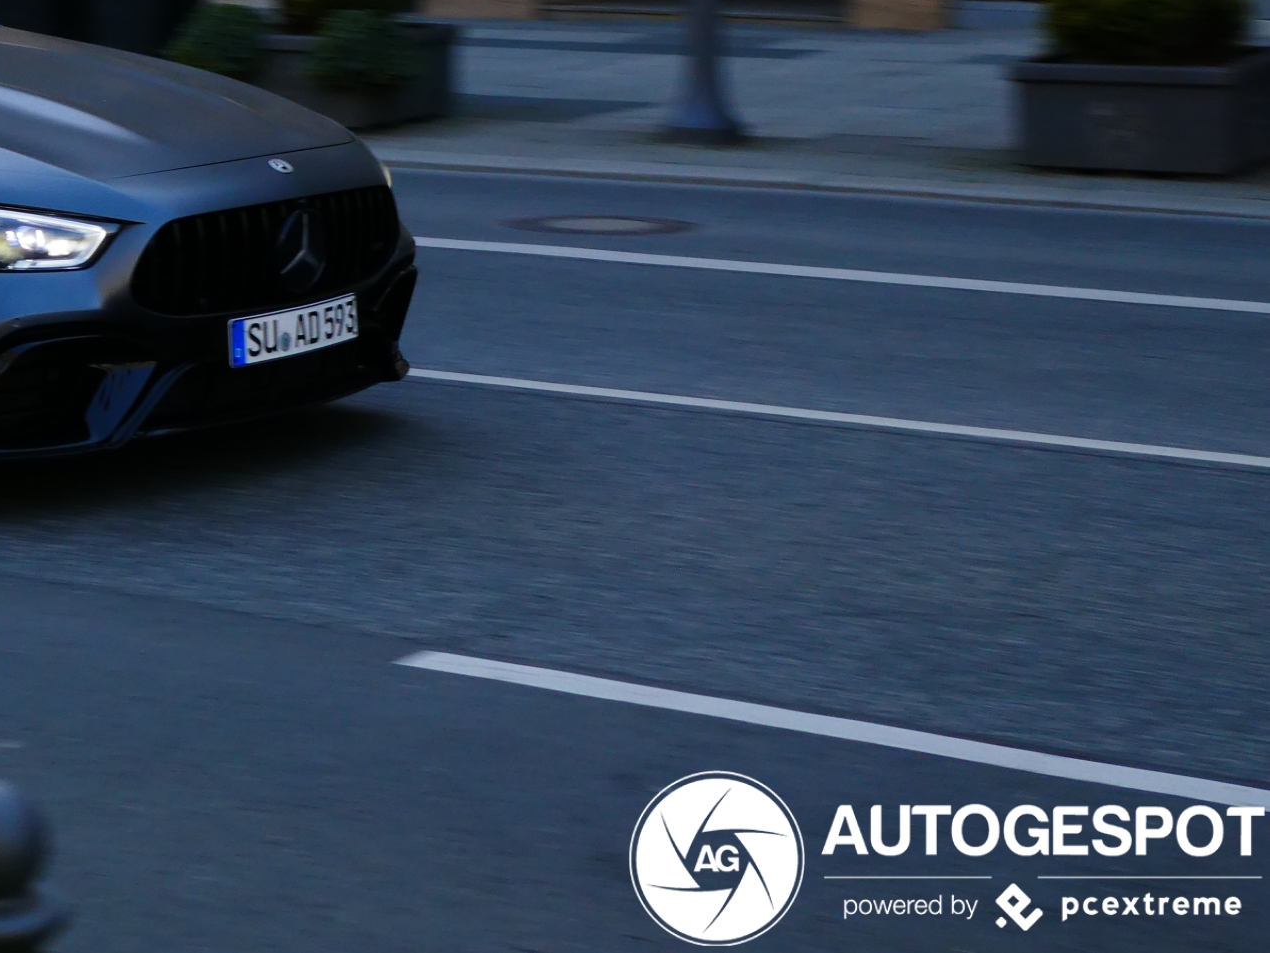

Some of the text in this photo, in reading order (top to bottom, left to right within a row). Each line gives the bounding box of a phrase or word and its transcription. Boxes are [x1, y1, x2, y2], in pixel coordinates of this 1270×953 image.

[248, 299, 357, 357] SU AD 593
